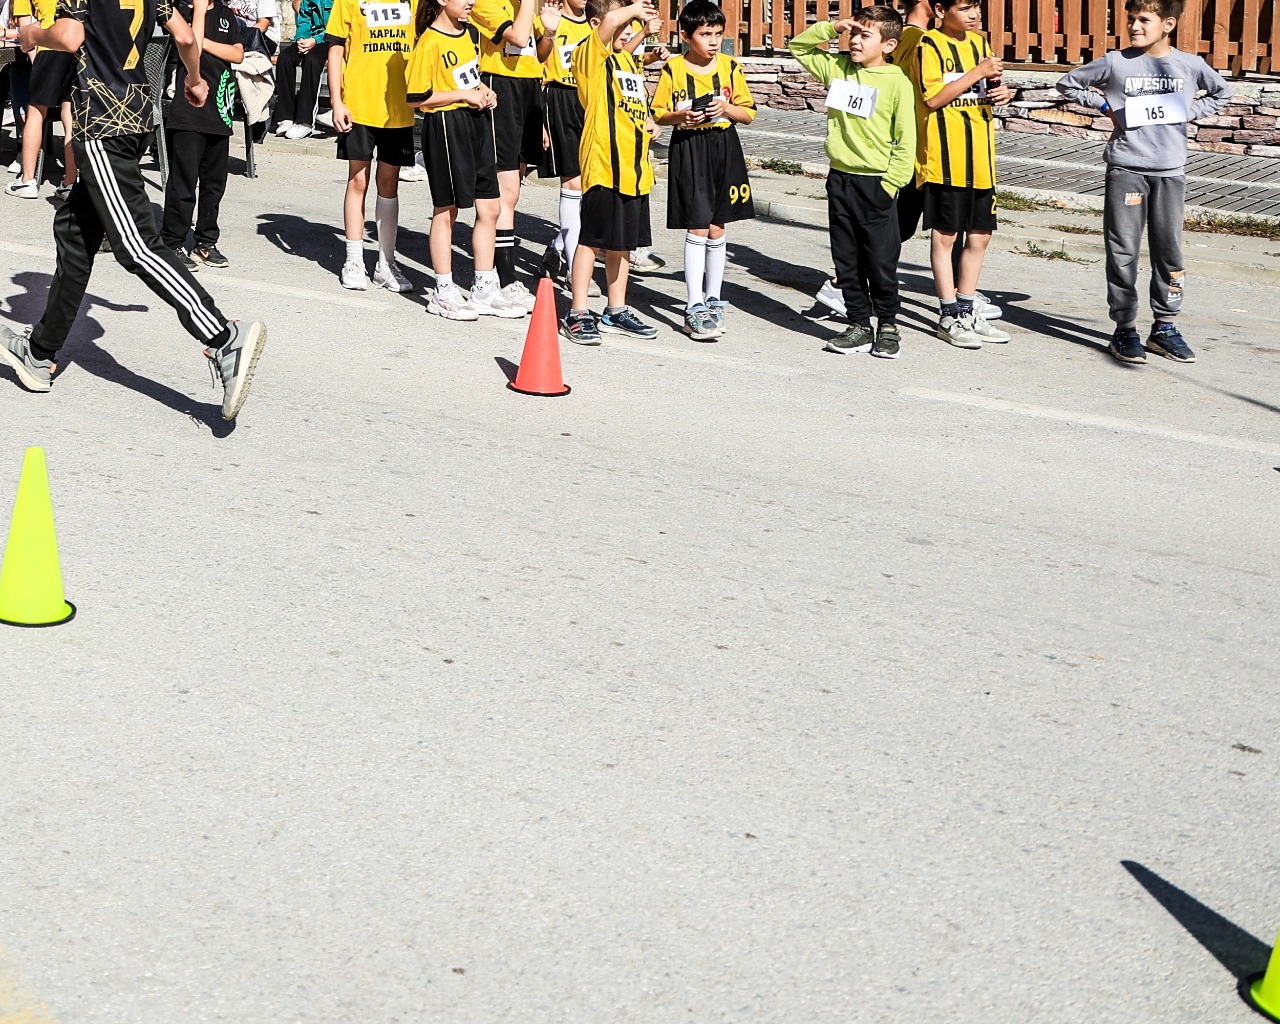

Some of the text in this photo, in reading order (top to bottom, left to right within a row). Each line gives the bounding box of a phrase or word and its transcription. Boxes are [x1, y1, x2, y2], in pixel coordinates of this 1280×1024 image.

[371, 8, 401, 22] 115
[369, 29, 407, 39] KAPLAN
[441, 50, 458, 69] 10
[1124, 77, 1184, 93] AWESOME
[847, 95, 863, 111] 161
[1145, 106, 1165, 121] 165
[729, 183, 751, 205] 99
